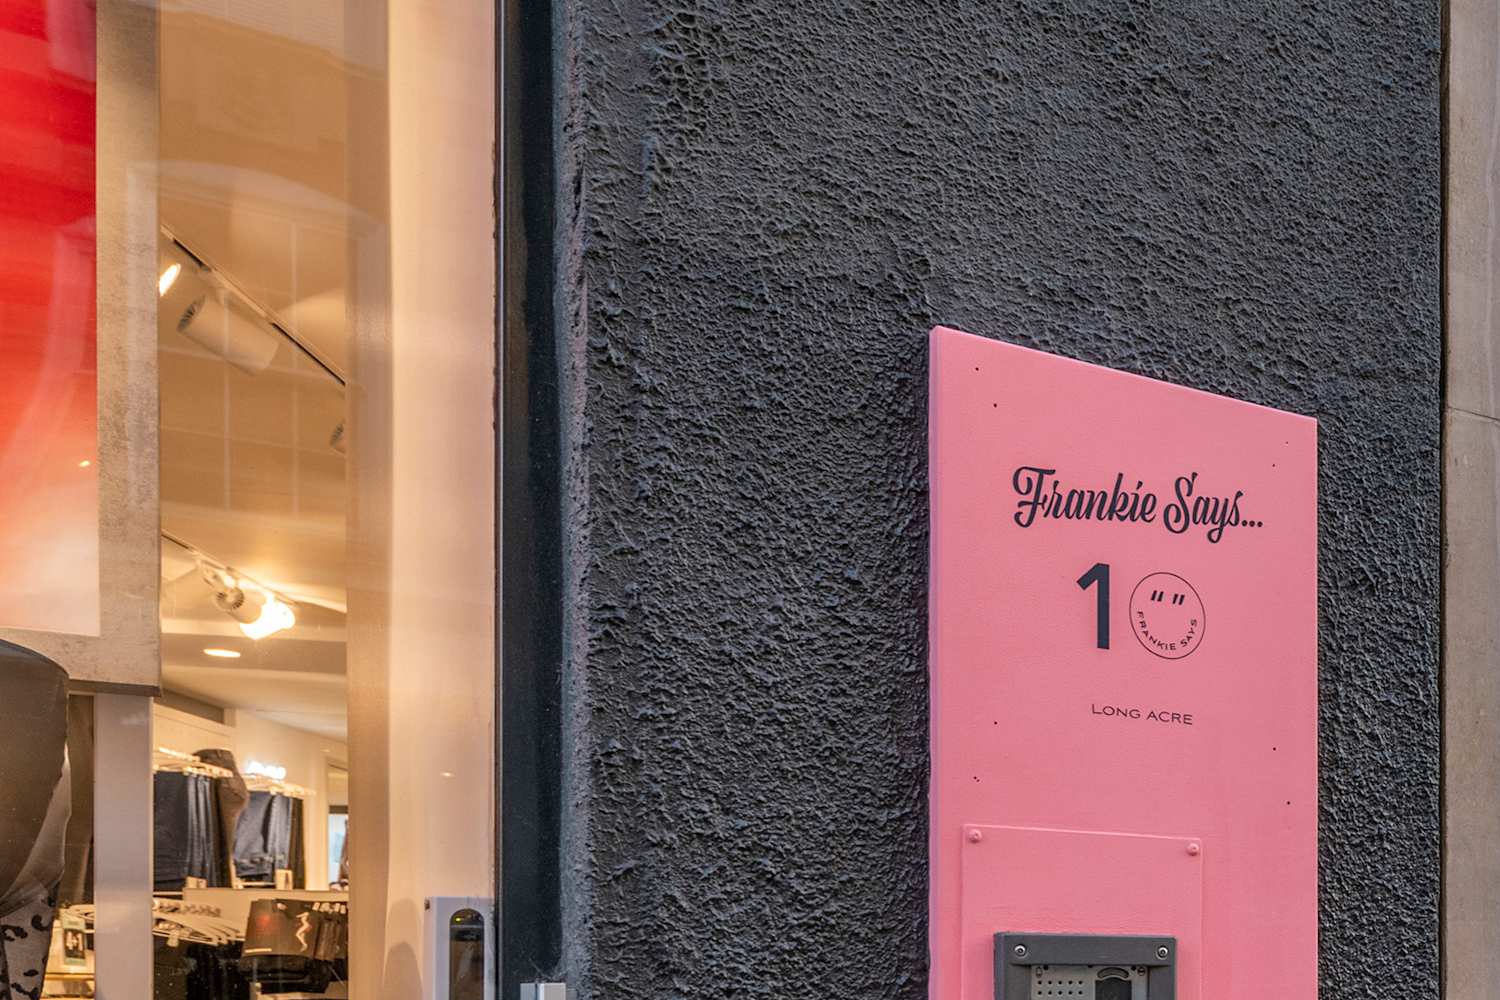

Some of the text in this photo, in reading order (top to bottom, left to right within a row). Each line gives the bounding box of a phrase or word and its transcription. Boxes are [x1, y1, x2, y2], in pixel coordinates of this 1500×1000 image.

[1012, 466, 1263, 544] Frankie Says...
[1137, 611, 1197, 650] FRANKIE SAYS
[1091, 703, 1193, 726] LONG ACRE
